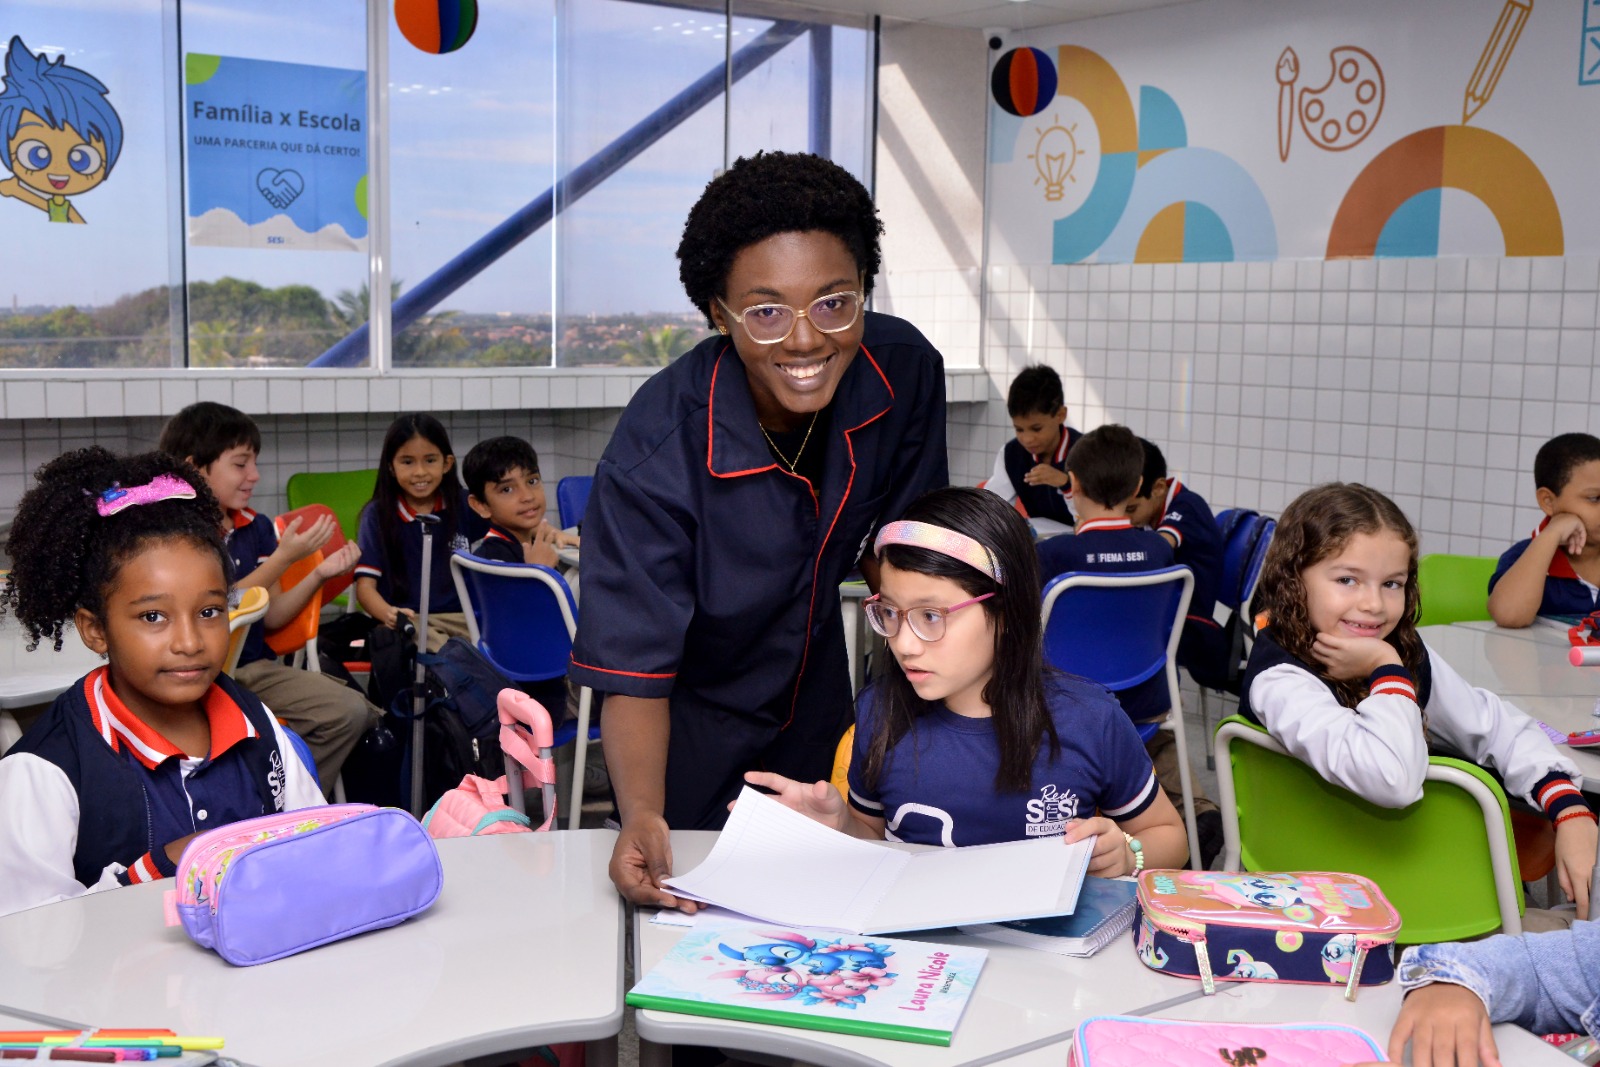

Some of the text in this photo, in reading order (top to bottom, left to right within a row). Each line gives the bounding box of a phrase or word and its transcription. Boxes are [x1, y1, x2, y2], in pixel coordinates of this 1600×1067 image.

[193, 100, 361, 132] Família x Escola
[193, 135, 361, 158] UMA PARCERIA QUE DÁ CERTO!
[1099, 551, 1145, 563] FIEMA SESI
[1041, 784, 1077, 802] Rede
[1026, 798, 1079, 823] SESI
[898, 951, 950, 1011] Laura Nicole
